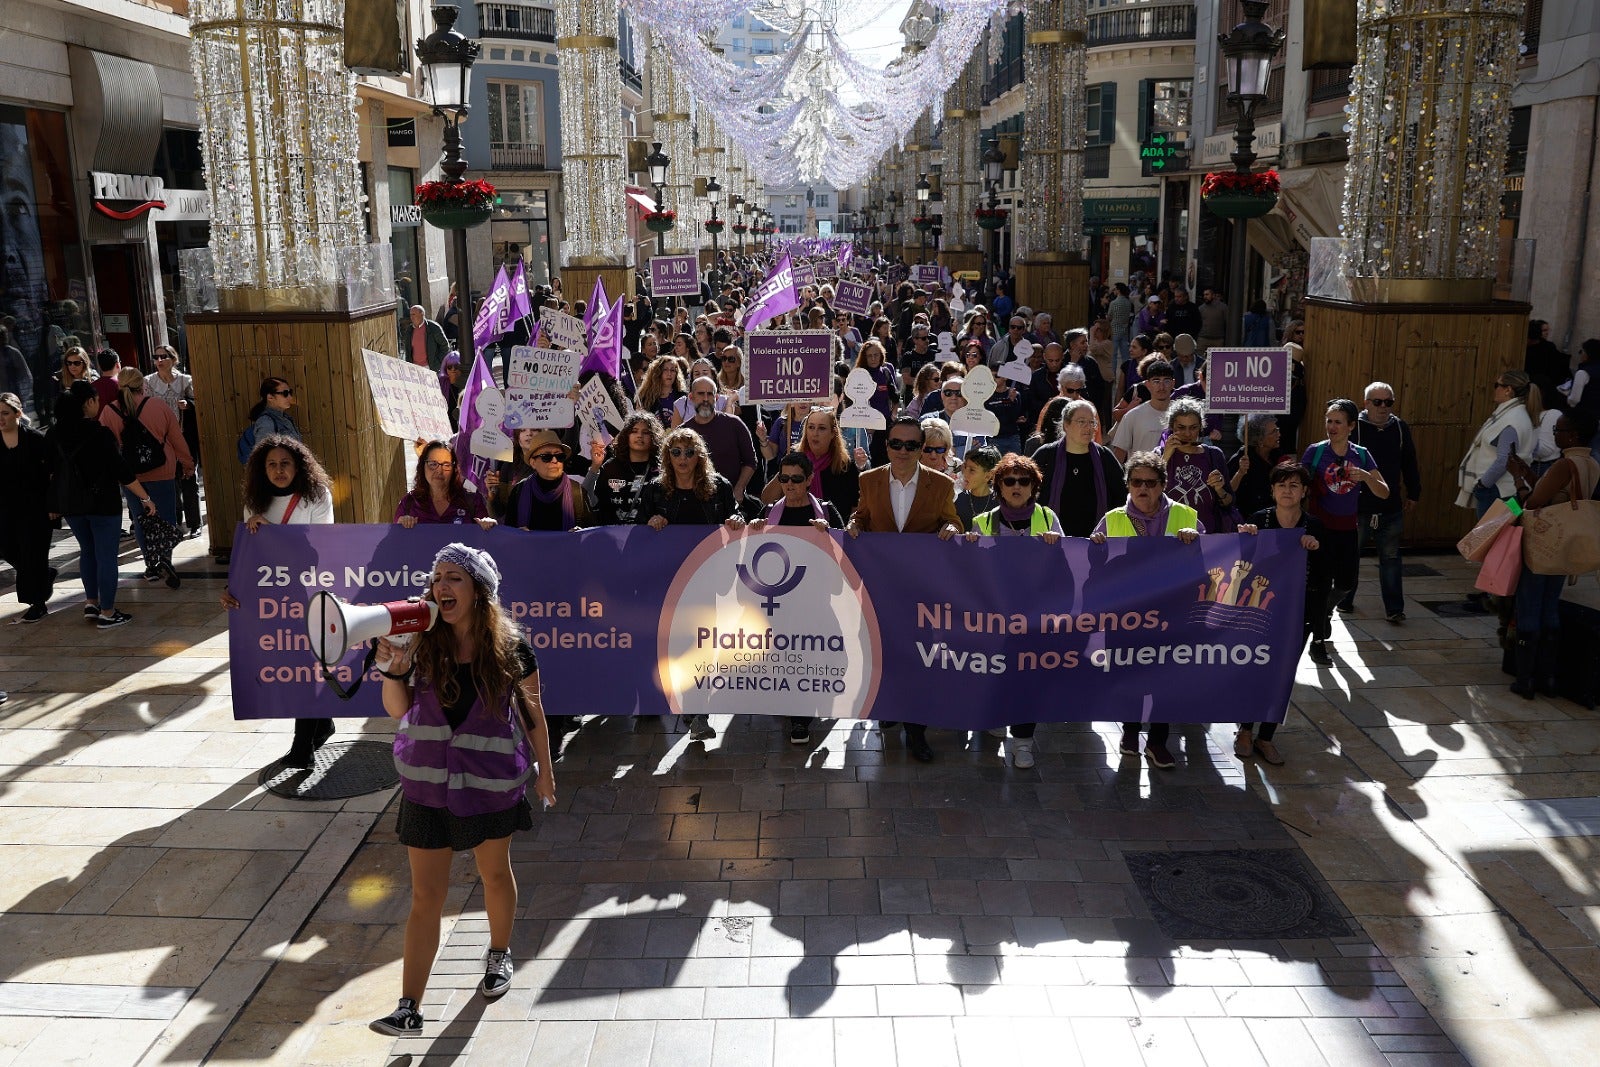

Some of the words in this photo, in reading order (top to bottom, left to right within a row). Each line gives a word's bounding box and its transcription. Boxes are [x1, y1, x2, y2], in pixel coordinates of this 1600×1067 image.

[91, 171, 164, 200] PRIMOR
[179, 197, 205, 214] DIOR
[1099, 204, 1142, 213] VIANDAS
[390, 205, 421, 223] MANGO
[660, 264, 669, 275] DI
[672, 260, 688, 274] NO
[843, 286, 850, 295] DI
[852, 286, 864, 298] NO
[776, 337, 795, 345] Ante
[515, 348, 530, 358] MI
[534, 350, 571, 364] CUERPO
[752, 346, 787, 355] Violencia
[788, 346, 798, 354] de
[799, 346, 827, 354] Género
[523, 361, 539, 374] NO
[542, 363, 573, 377] QUIERE
[776, 357, 804, 376] ¡NO
[1224, 361, 1239, 378] DI
[1246, 356, 1272, 378] NO
[511, 373, 528, 386] TU
[760, 379, 774, 395] TE
[776, 378, 821, 395] CALLES!
[1221, 384, 1227, 392] A
[1228, 384, 1236, 392] la
[1237, 384, 1275, 392] Violencia
[509, 393, 524, 401] NO
[1211, 395, 1237, 403] contra
[1238, 395, 1250, 403] las
[1251, 395, 1285, 404] mujeres
[257, 565, 291, 587] 25
[299, 565, 335, 588] de
[344, 564, 427, 588] Novie
[259, 596, 304, 619] Día
[511, 601, 572, 620] para
[581, 596, 603, 618] la
[916, 602, 952, 631] Ni
[964, 609, 1028, 635] una
[1041, 608, 1169, 635] menos,
[524, 626, 633, 649] iolencia
[697, 627, 844, 652] Plataforma
[733, 650, 780, 663] contra
[785, 651, 803, 663] las
[915, 640, 1007, 675] Vivas
[1018, 648, 1079, 672] nos
[1090, 642, 1271, 673] queremos
[694, 661, 768, 674] violencias
[772, 663, 846, 677] machistas
[693, 675, 790, 691] VIOLENCIA
[796, 678, 846, 693] CERO
